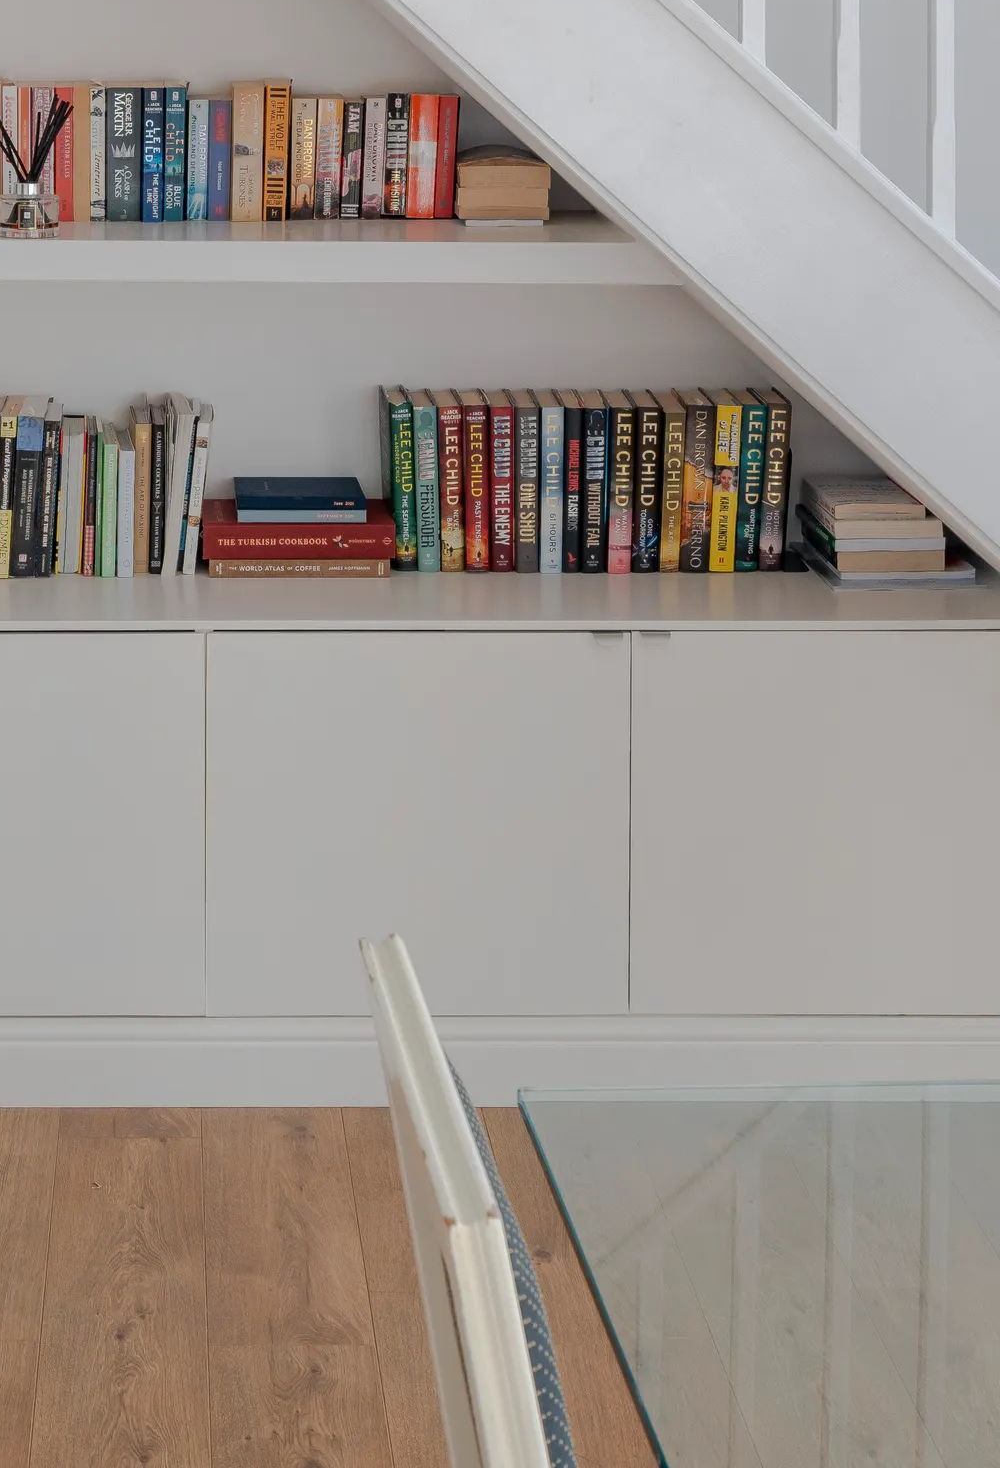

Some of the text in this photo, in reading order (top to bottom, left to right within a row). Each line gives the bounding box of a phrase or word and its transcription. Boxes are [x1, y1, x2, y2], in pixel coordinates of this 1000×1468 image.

[271, 100, 276, 109] OF
[275, 101, 285, 151] THE WOLF
[348, 106, 360, 133] JAM
[145, 120, 153, 162] CHILD
[166, 123, 174, 162] CHILD
[176, 131, 184, 154] LEE
[303, 119, 313, 178] DAN BROWN
[390, 170, 401, 211] THE VISITOR
[470, 425, 482, 497] LEE CHILD
[494, 416, 510, 477] LEE CHILD
[568, 440, 579, 491] MICHAEL LEWIS
[640, 412, 657, 506] LEE CHILD
[694, 411, 707, 491] DAN BROWN
[420, 485, 434, 547] PERSUADER
[494, 483, 510, 545] THE ENEMY
[520, 483, 536, 544] ONE SHOT
[549, 513, 557, 552] 61 HOURS
[587, 482, 601, 548] WITHOUT FAIL
[718, 497, 730, 551] KARL PILKINGTON
